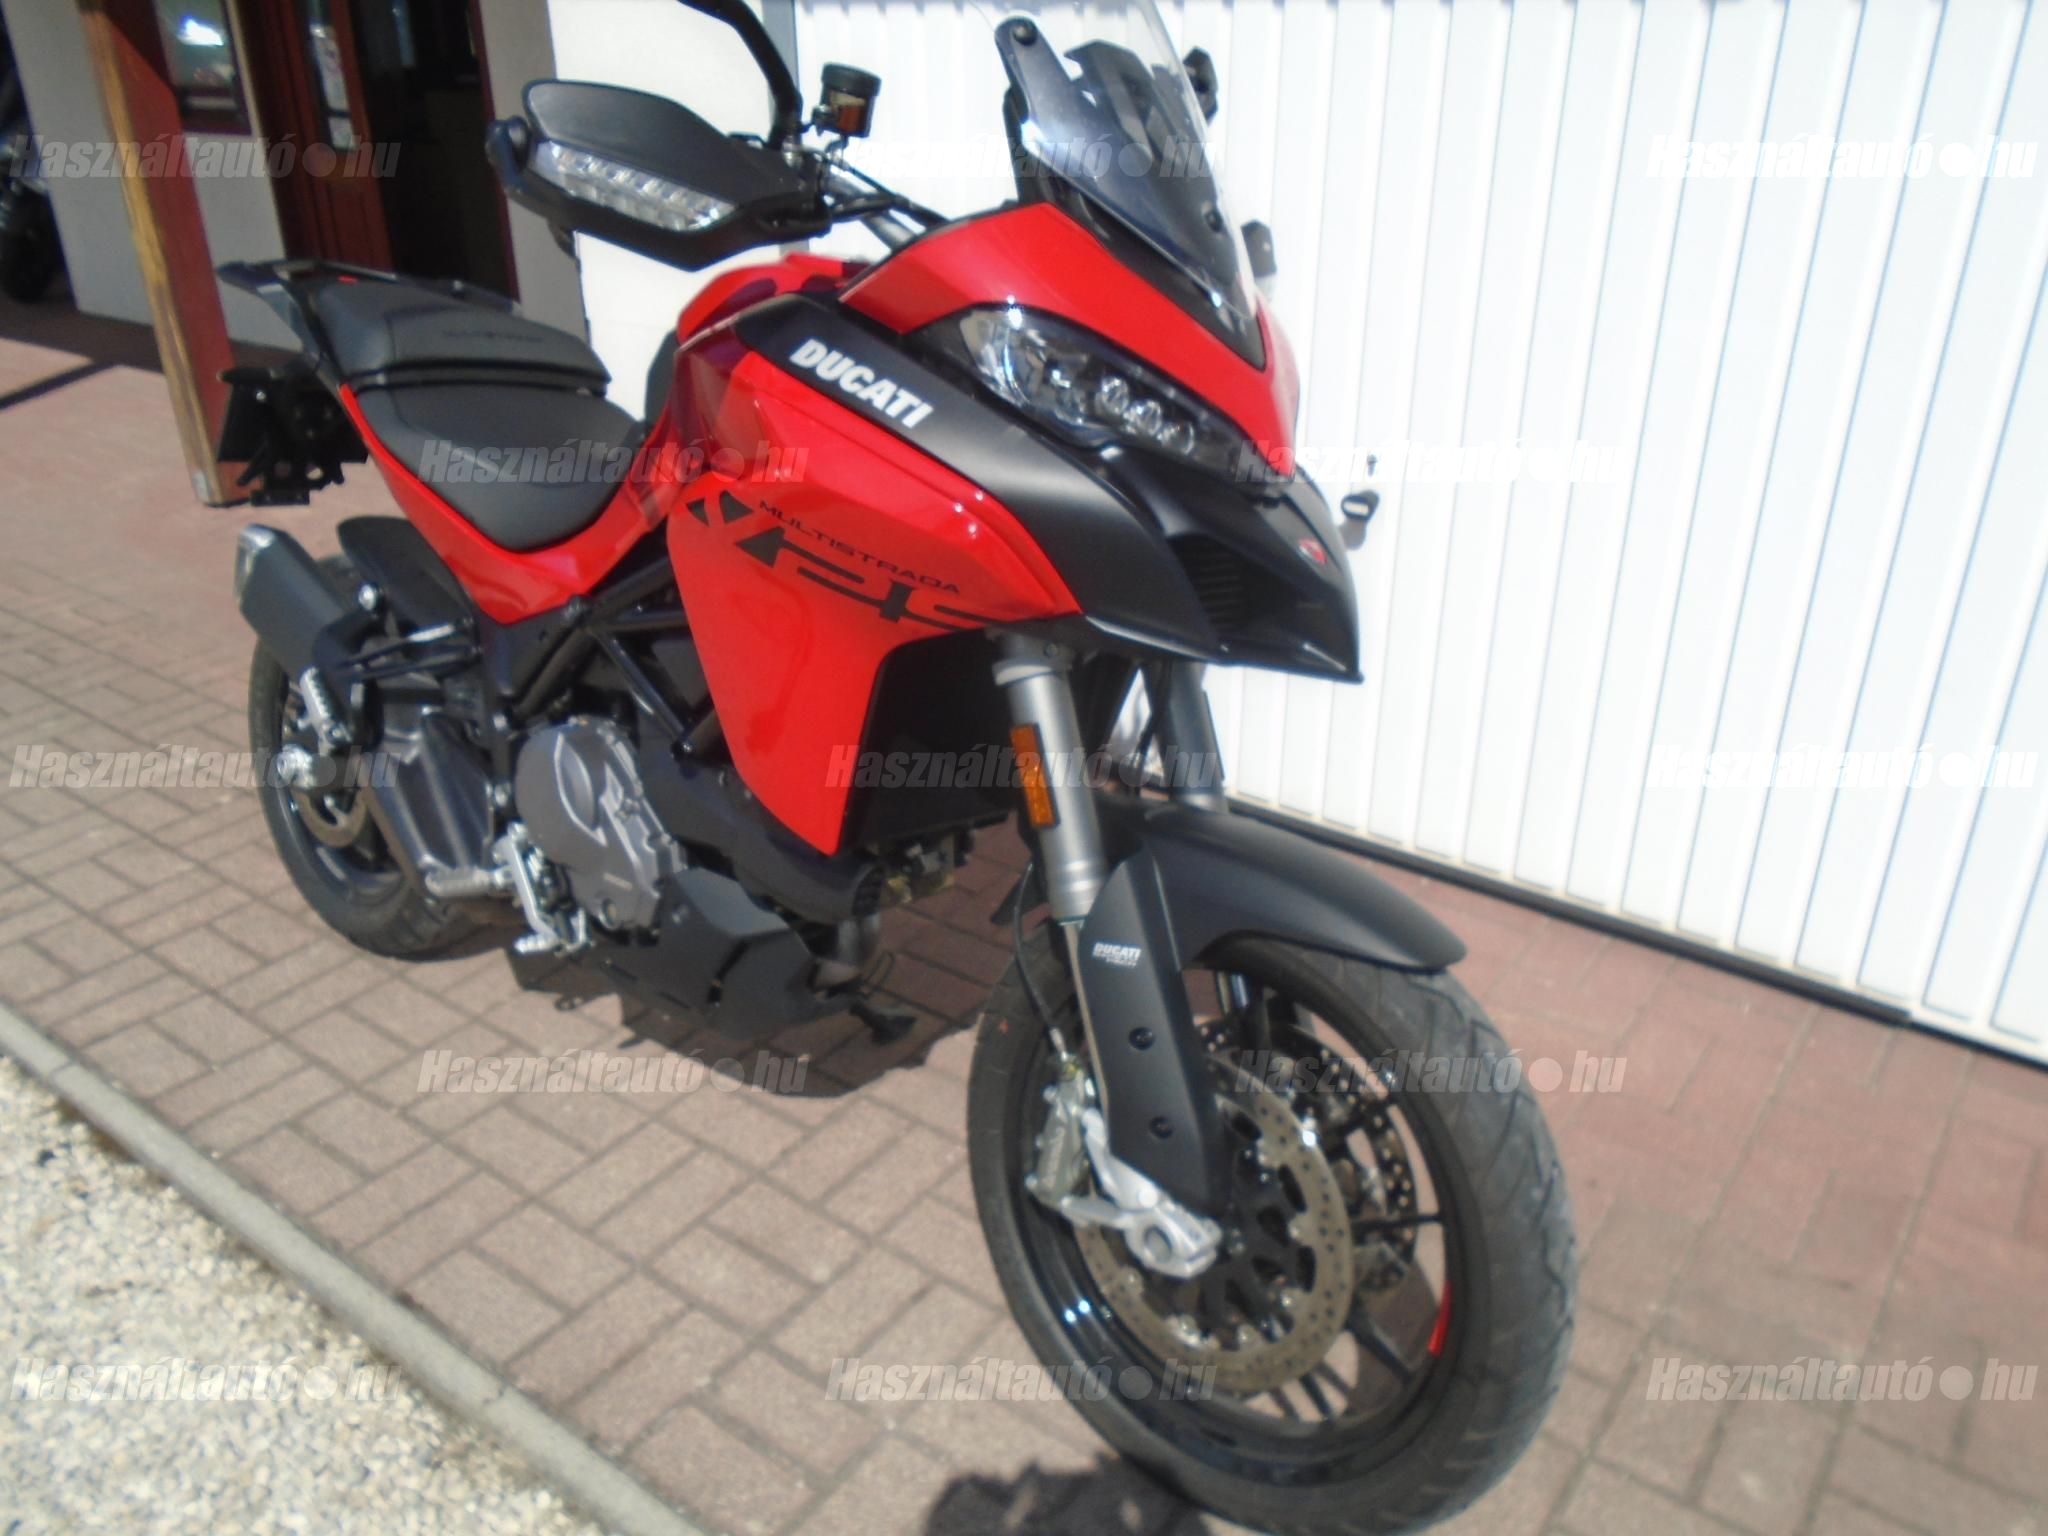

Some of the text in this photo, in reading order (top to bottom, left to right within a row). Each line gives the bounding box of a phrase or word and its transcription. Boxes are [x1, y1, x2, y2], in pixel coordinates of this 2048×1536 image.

[789, 338, 934, 429] DUCATI
[758, 499, 961, 596] MULTISTRADA
[1092, 942, 1142, 961] DUCATI
